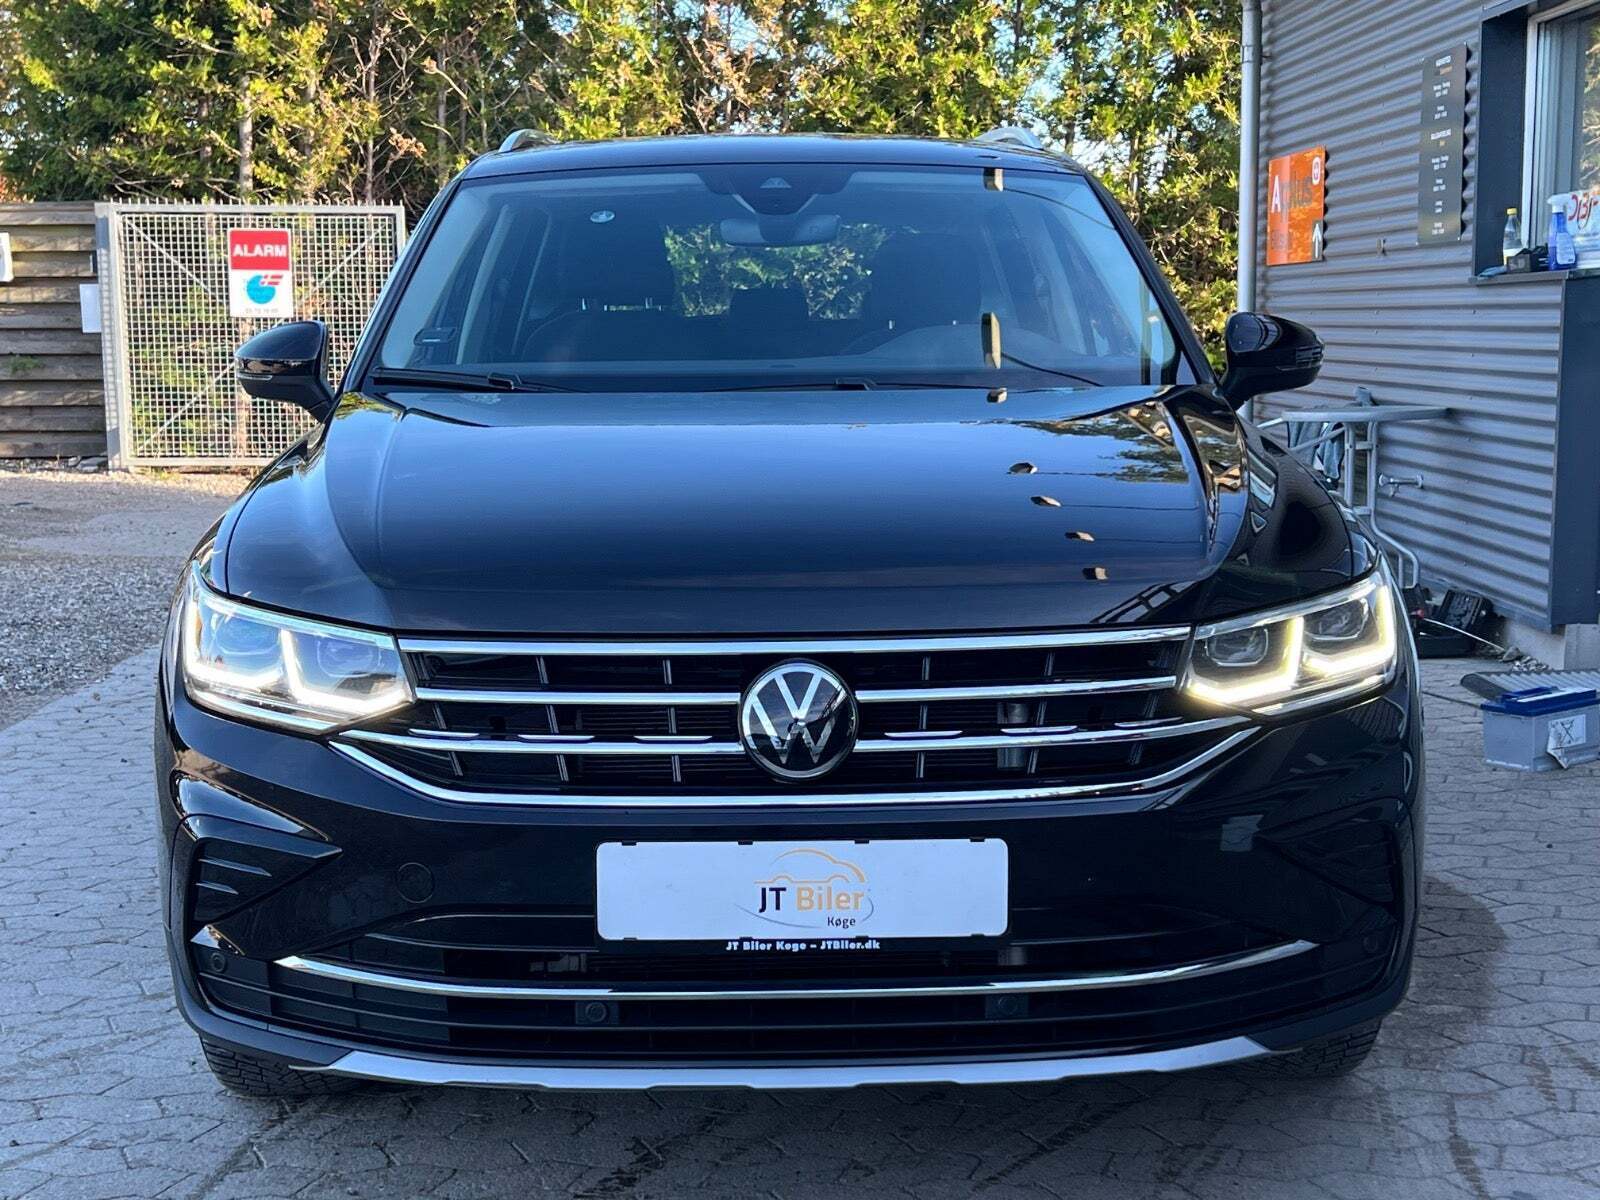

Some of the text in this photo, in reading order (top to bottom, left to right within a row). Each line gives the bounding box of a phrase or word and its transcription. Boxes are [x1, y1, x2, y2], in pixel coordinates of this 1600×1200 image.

[232, 244, 287, 257] ALARM
[759, 886, 865, 913] JT Biler
[827, 916, 856, 929] Køge
[725, 941, 739, 951] JT
[743, 940, 773, 950] Biler
[820, 939, 881, 950] JTBiler.dk
